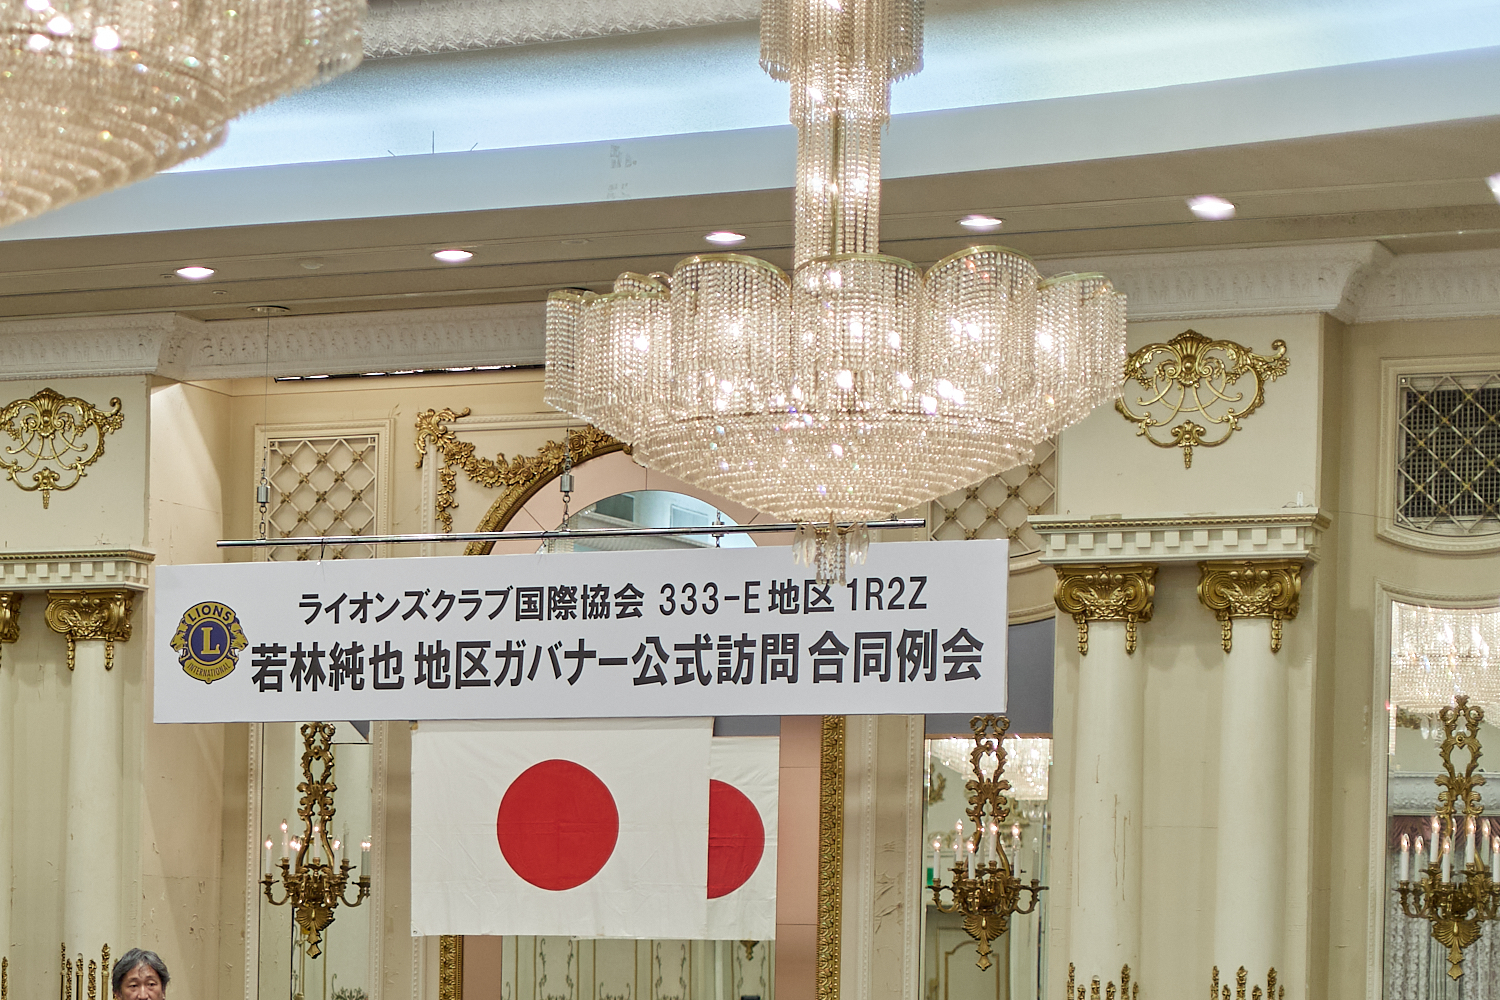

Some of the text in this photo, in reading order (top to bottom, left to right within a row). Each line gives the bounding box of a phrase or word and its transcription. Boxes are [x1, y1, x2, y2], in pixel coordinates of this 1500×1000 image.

[299, 583, 645, 625] ライオンズクラブ国際協会
[847, 576, 928, 611] 1R2Z
[187, 604, 232, 622] LIONS
[201, 627, 220, 655] L
[186, 661, 231, 678] INTERNATIONAL
